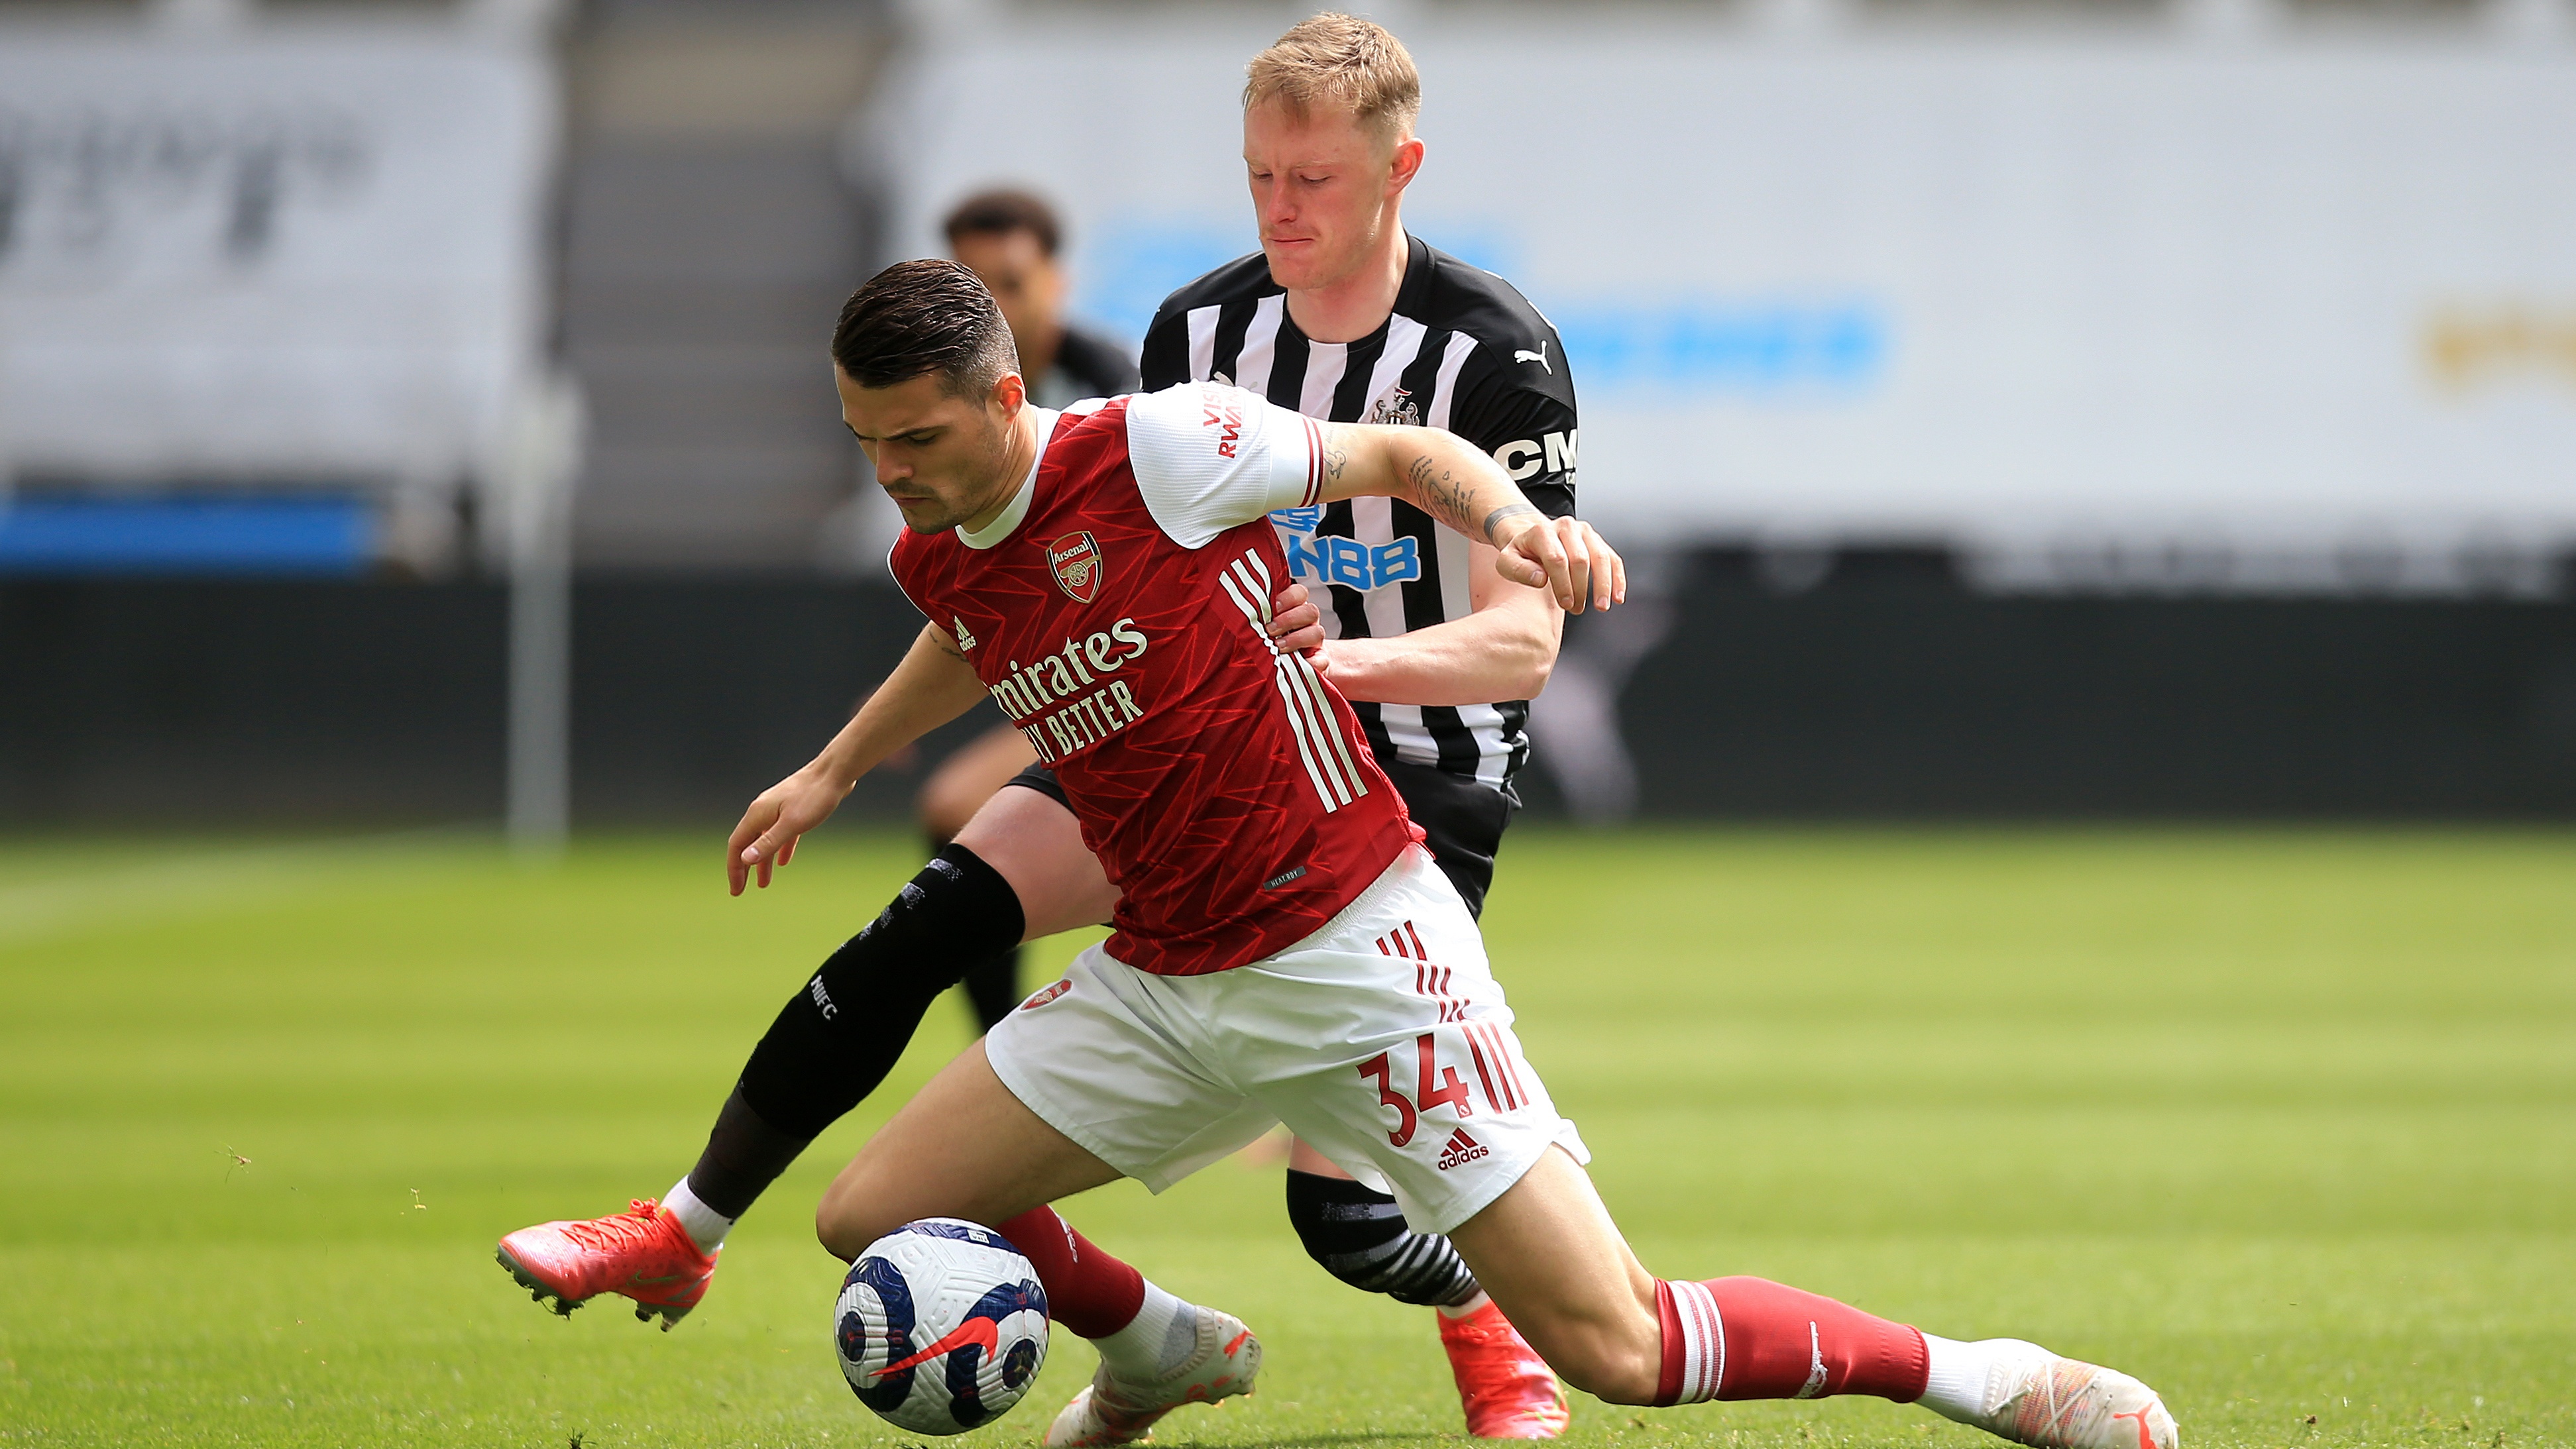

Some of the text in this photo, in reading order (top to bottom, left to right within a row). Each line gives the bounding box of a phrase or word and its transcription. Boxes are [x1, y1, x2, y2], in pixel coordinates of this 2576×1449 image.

[1054, 540, 1090, 564] Arsenal
[981, 617, 1148, 721] mirates
[1044, 680, 1144, 756] BETTER
[810, 974, 838, 1020] NUFC
[1355, 1032, 1473, 1148] 34
[1437, 1146, 1489, 1171] adidas
